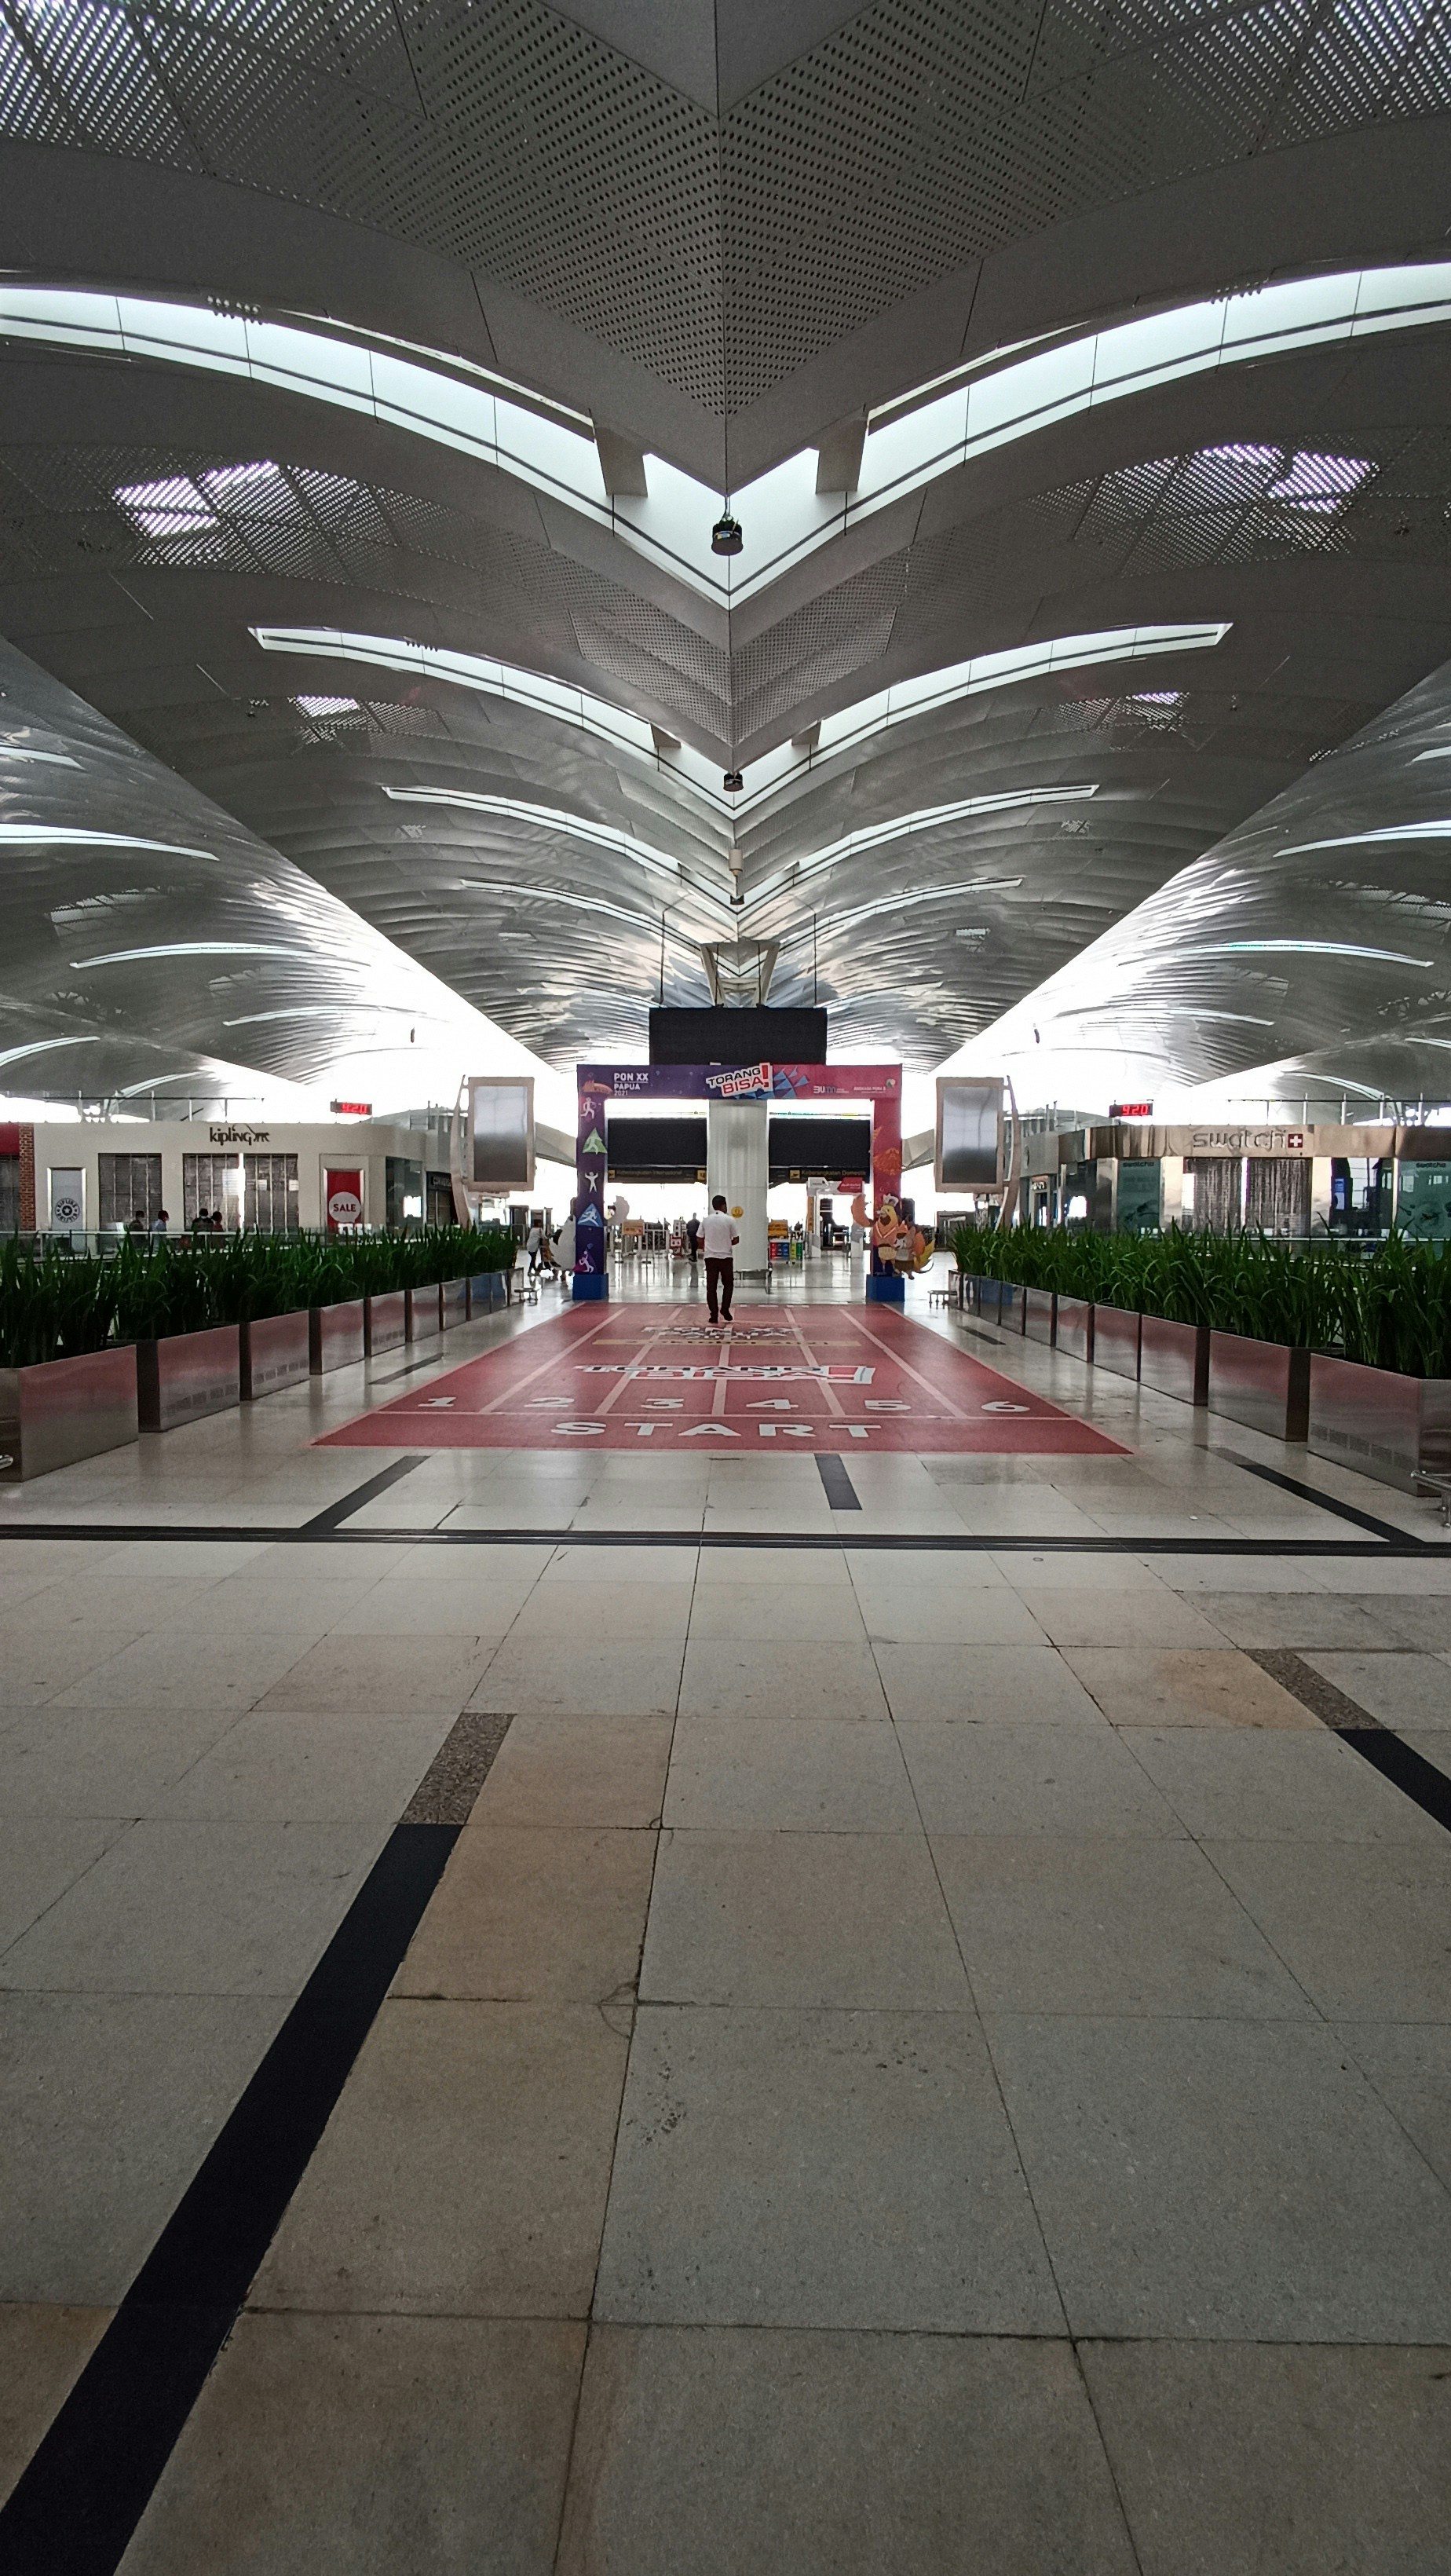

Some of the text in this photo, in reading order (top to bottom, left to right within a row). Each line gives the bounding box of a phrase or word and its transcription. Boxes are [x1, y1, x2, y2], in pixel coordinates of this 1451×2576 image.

[613, 1073, 649, 1081] PON XX
[708, 1067, 761, 1086] TORANG
[722, 1064, 769, 1095] BISA!
[209, 1125, 253, 1146] kipling
[1192, 1129, 1288, 1152] swatch
[333, 1203, 356, 1213] SALE
[418, 1396, 457, 1407] 1
[524, 1397, 575, 1408] 2
[641, 1398, 685, 1410] 3
[746, 1399, 799, 1410] 4
[864, 1400, 912, 1411] 5
[981, 1400, 1031, 1413] 6
[551, 1422, 882, 1438] START
